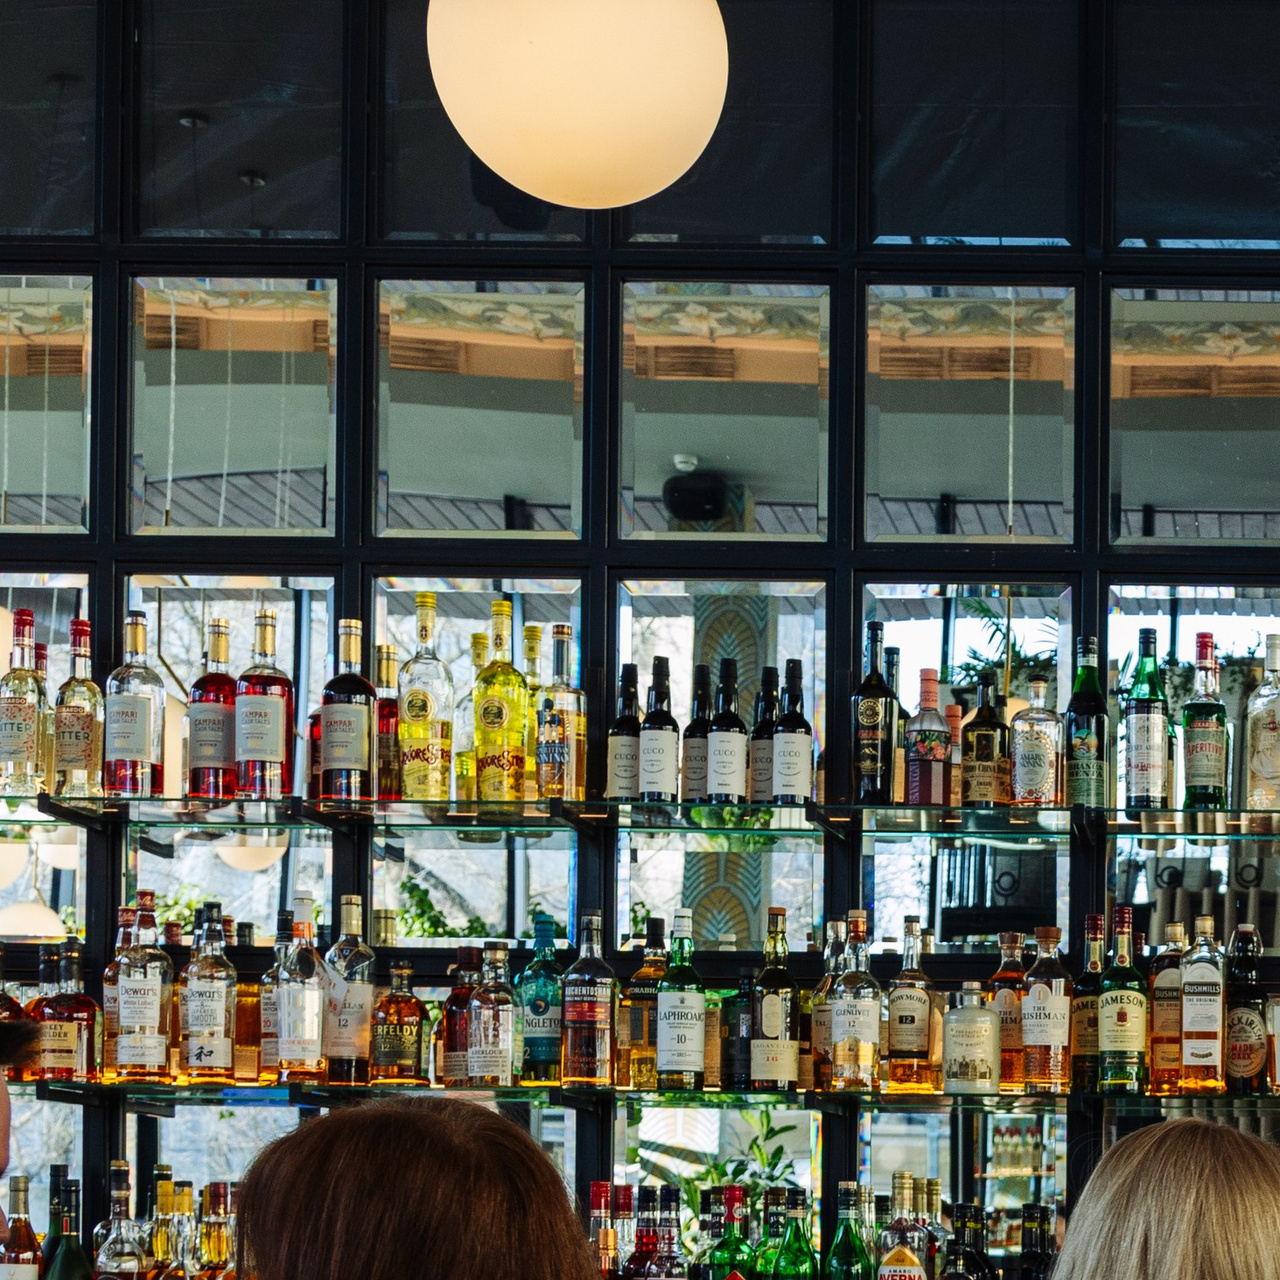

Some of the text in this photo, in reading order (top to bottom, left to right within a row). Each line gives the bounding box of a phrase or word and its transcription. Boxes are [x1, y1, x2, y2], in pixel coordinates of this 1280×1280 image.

[0, 722, 32, 732] ITTER
[614, 752, 637, 761] CUCO
[713, 749, 736, 757] CUCO
[685, 755, 707, 763] CUCO
[121, 985, 157, 997] Dewar's
[1184, 984, 1220, 993] BUSHMILLS
[188, 988, 222, 999] Dewar's
[1155, 989, 1179, 998] BUSHM
[1100, 994, 1143, 1009] JAMESON
[1072, 1000, 1097, 1013] JAME
[835, 1009, 870, 1017] GLENLIVET
[1023, 1012, 1065, 1020] RISHMAN
[337, 1018, 349, 1027] 12
[525, 1018, 560, 1028] NGLETO
[374, 1025, 418, 1036] ERFELDY
[676, 1033, 686, 1043] 10
